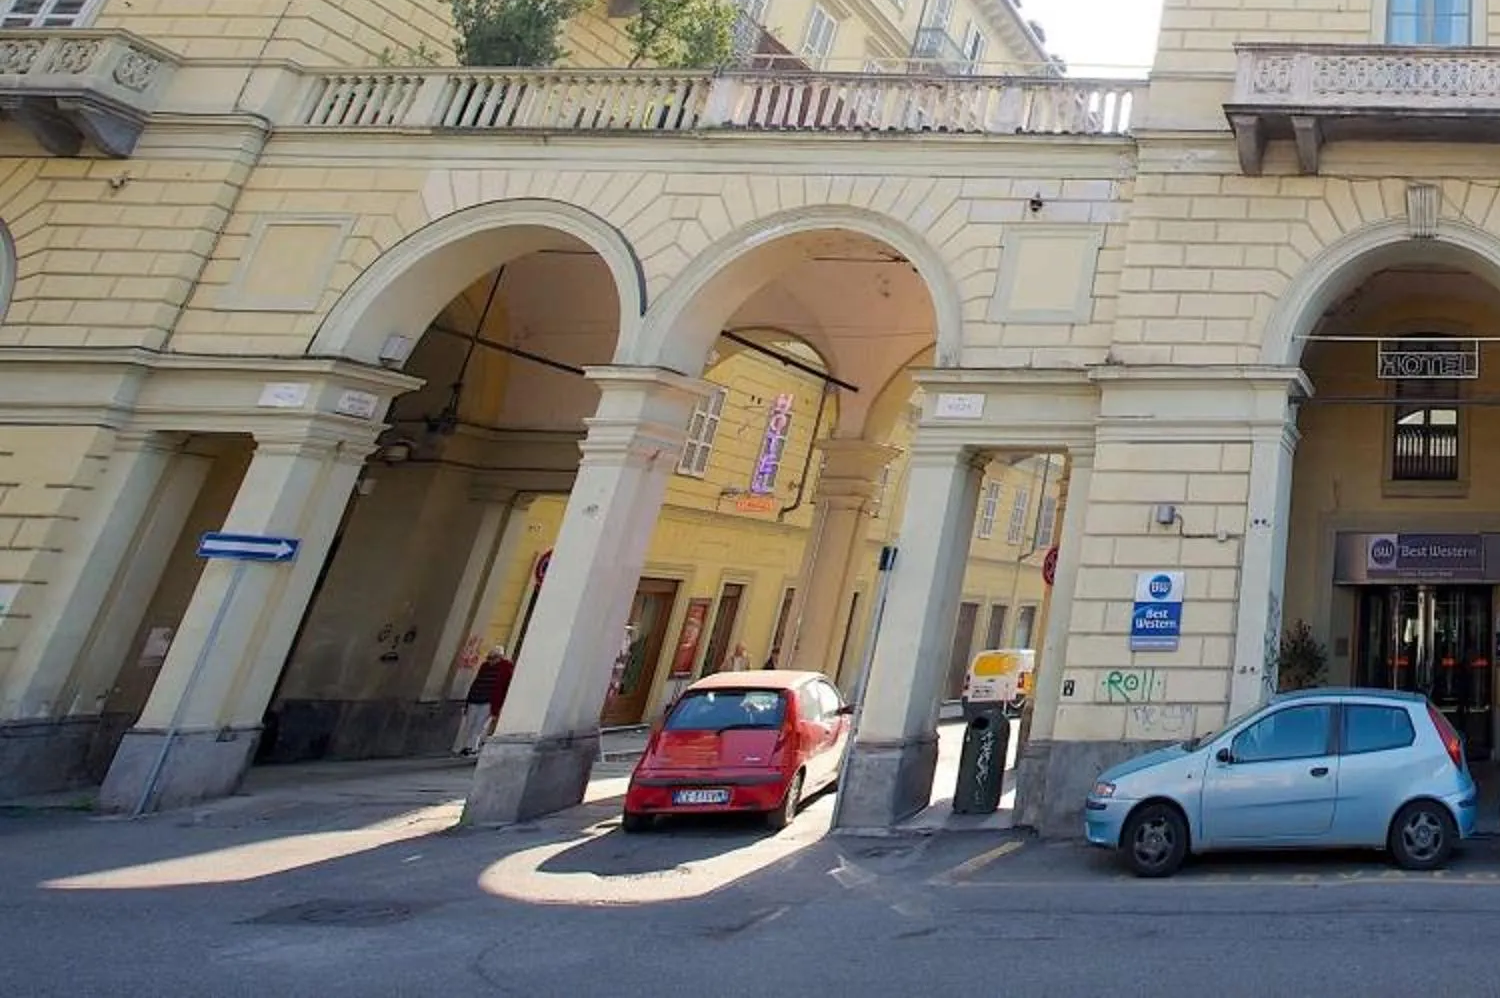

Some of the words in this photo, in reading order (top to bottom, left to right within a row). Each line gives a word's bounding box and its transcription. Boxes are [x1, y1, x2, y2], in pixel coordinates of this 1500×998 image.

[1381, 354, 1474, 375] HOTEL
[751, 393, 794, 494] HOTEL
[1401, 545, 1427, 557] Best
[1430, 544, 1477, 558] Western
[1145, 609, 1168, 618] Best
[1135, 618, 1176, 629] Western
